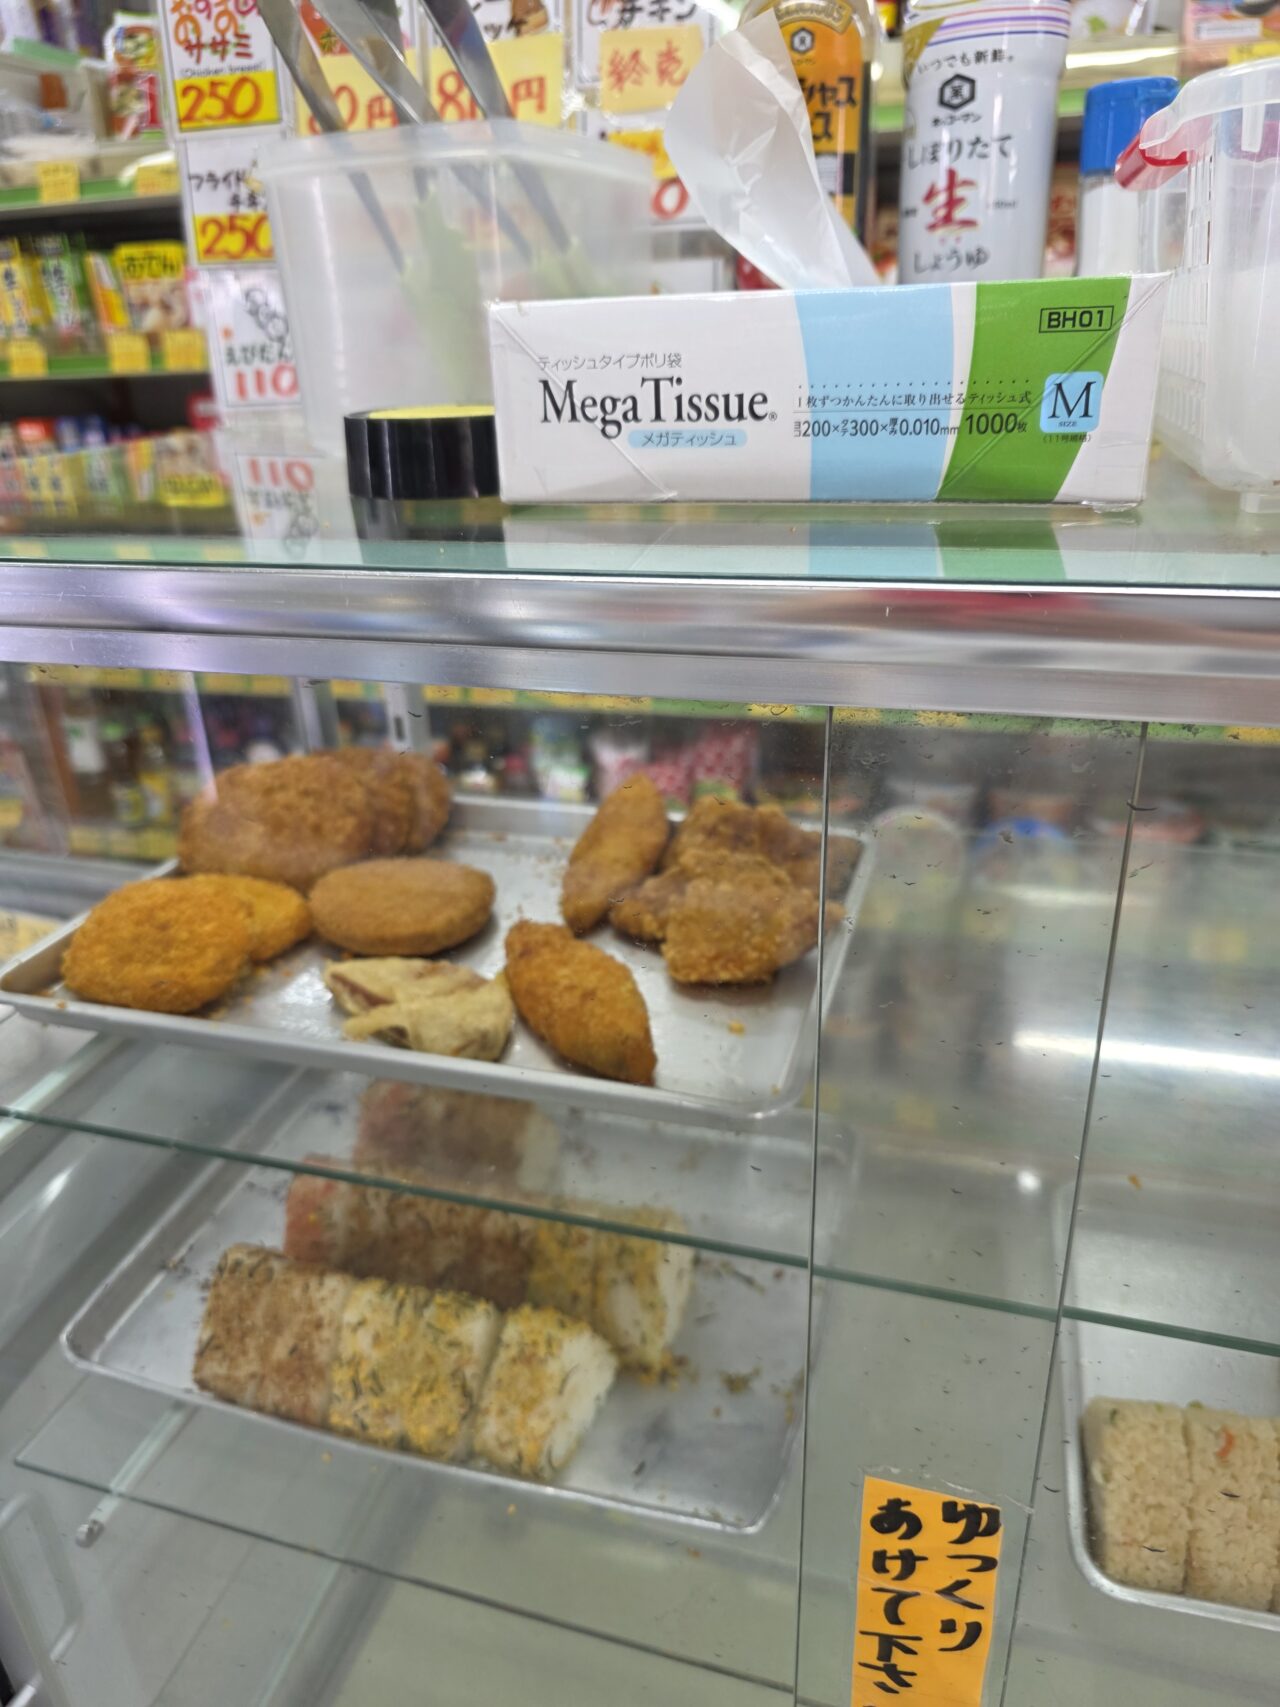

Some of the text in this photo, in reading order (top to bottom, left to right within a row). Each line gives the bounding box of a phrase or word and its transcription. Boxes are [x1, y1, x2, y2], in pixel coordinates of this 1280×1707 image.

[181, 76, 263, 124] 250
[922, 167, 978, 232] 生
[914, 247, 990, 274] しょうゆ
[1047, 309, 1105, 328] BH01
[538, 352, 682, 371] ティッシュタイプポリ袋
[236, 363, 298, 400] 110
[1047, 381, 1097, 419] M
[641, 432, 738, 447] メガティッシュ
[936, 1501, 1001, 1651] ゆっくり
[858, 1498, 928, 1707] あけて下さ
